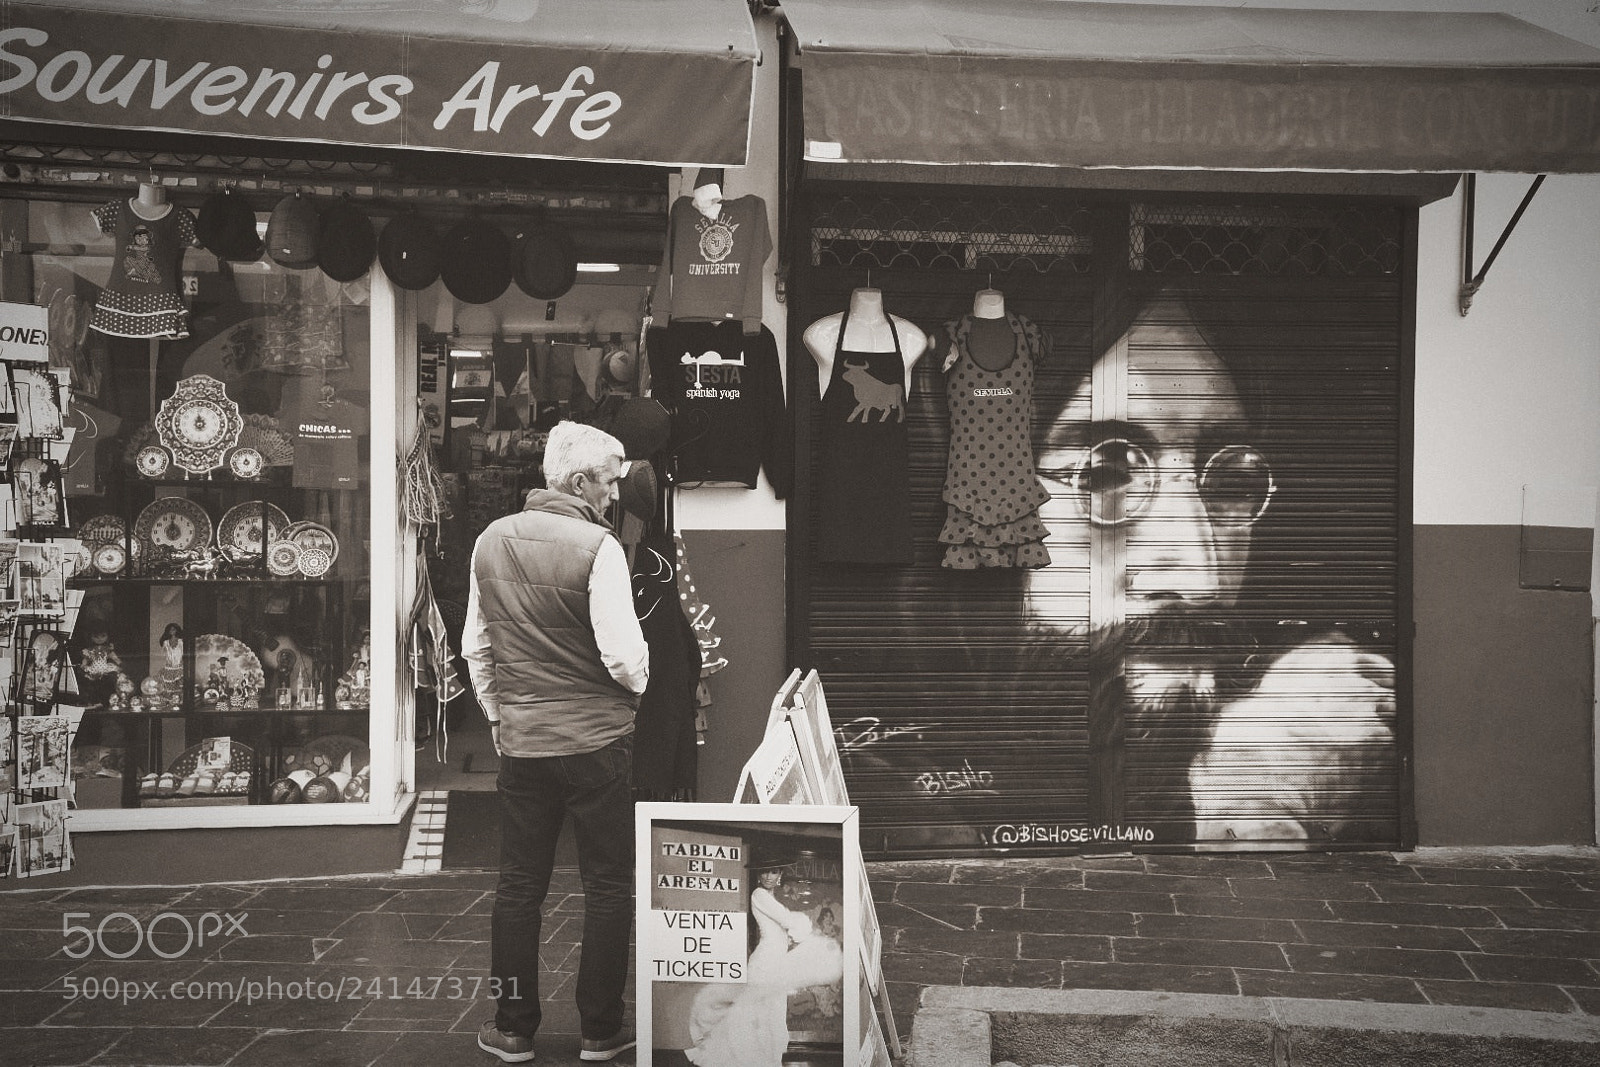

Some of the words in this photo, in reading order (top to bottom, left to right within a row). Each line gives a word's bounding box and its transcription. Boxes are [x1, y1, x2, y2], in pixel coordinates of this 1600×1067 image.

[0, 27, 414, 125] Souvenirs
[433, 61, 621, 140] Arfe
[688, 263, 741, 275] UNIVERSITY
[685, 365, 741, 384] SIESTA
[686, 388, 717, 400] spanish
[720, 389, 740, 400] yoga
[974, 387, 1013, 397] SEVILLA
[688, 860, 713, 873] EL
[664, 912, 733, 930] VENTA
[683, 936, 712, 953] DE
[653, 960, 742, 979] TICKETS
